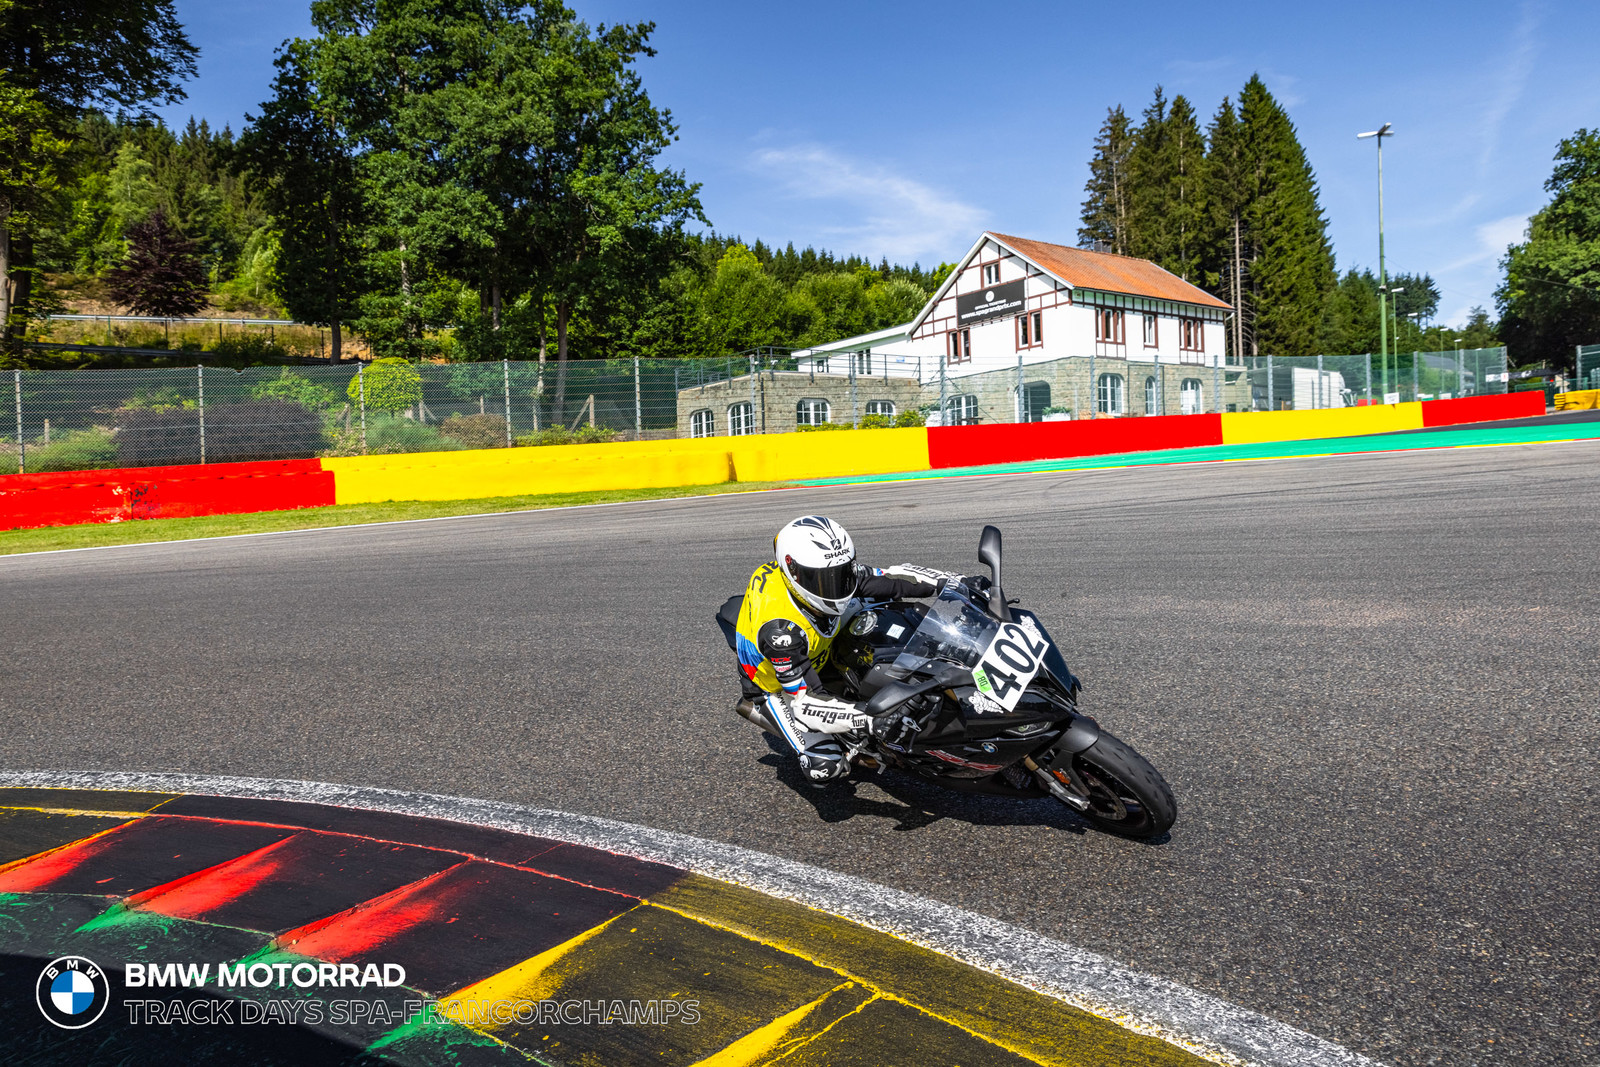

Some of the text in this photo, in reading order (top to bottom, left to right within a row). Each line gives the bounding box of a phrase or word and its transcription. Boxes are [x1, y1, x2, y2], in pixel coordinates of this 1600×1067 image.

[824, 548, 851, 560] SHARK
[981, 623, 1046, 700] 402
[782, 706, 806, 746] MOTORRAD
